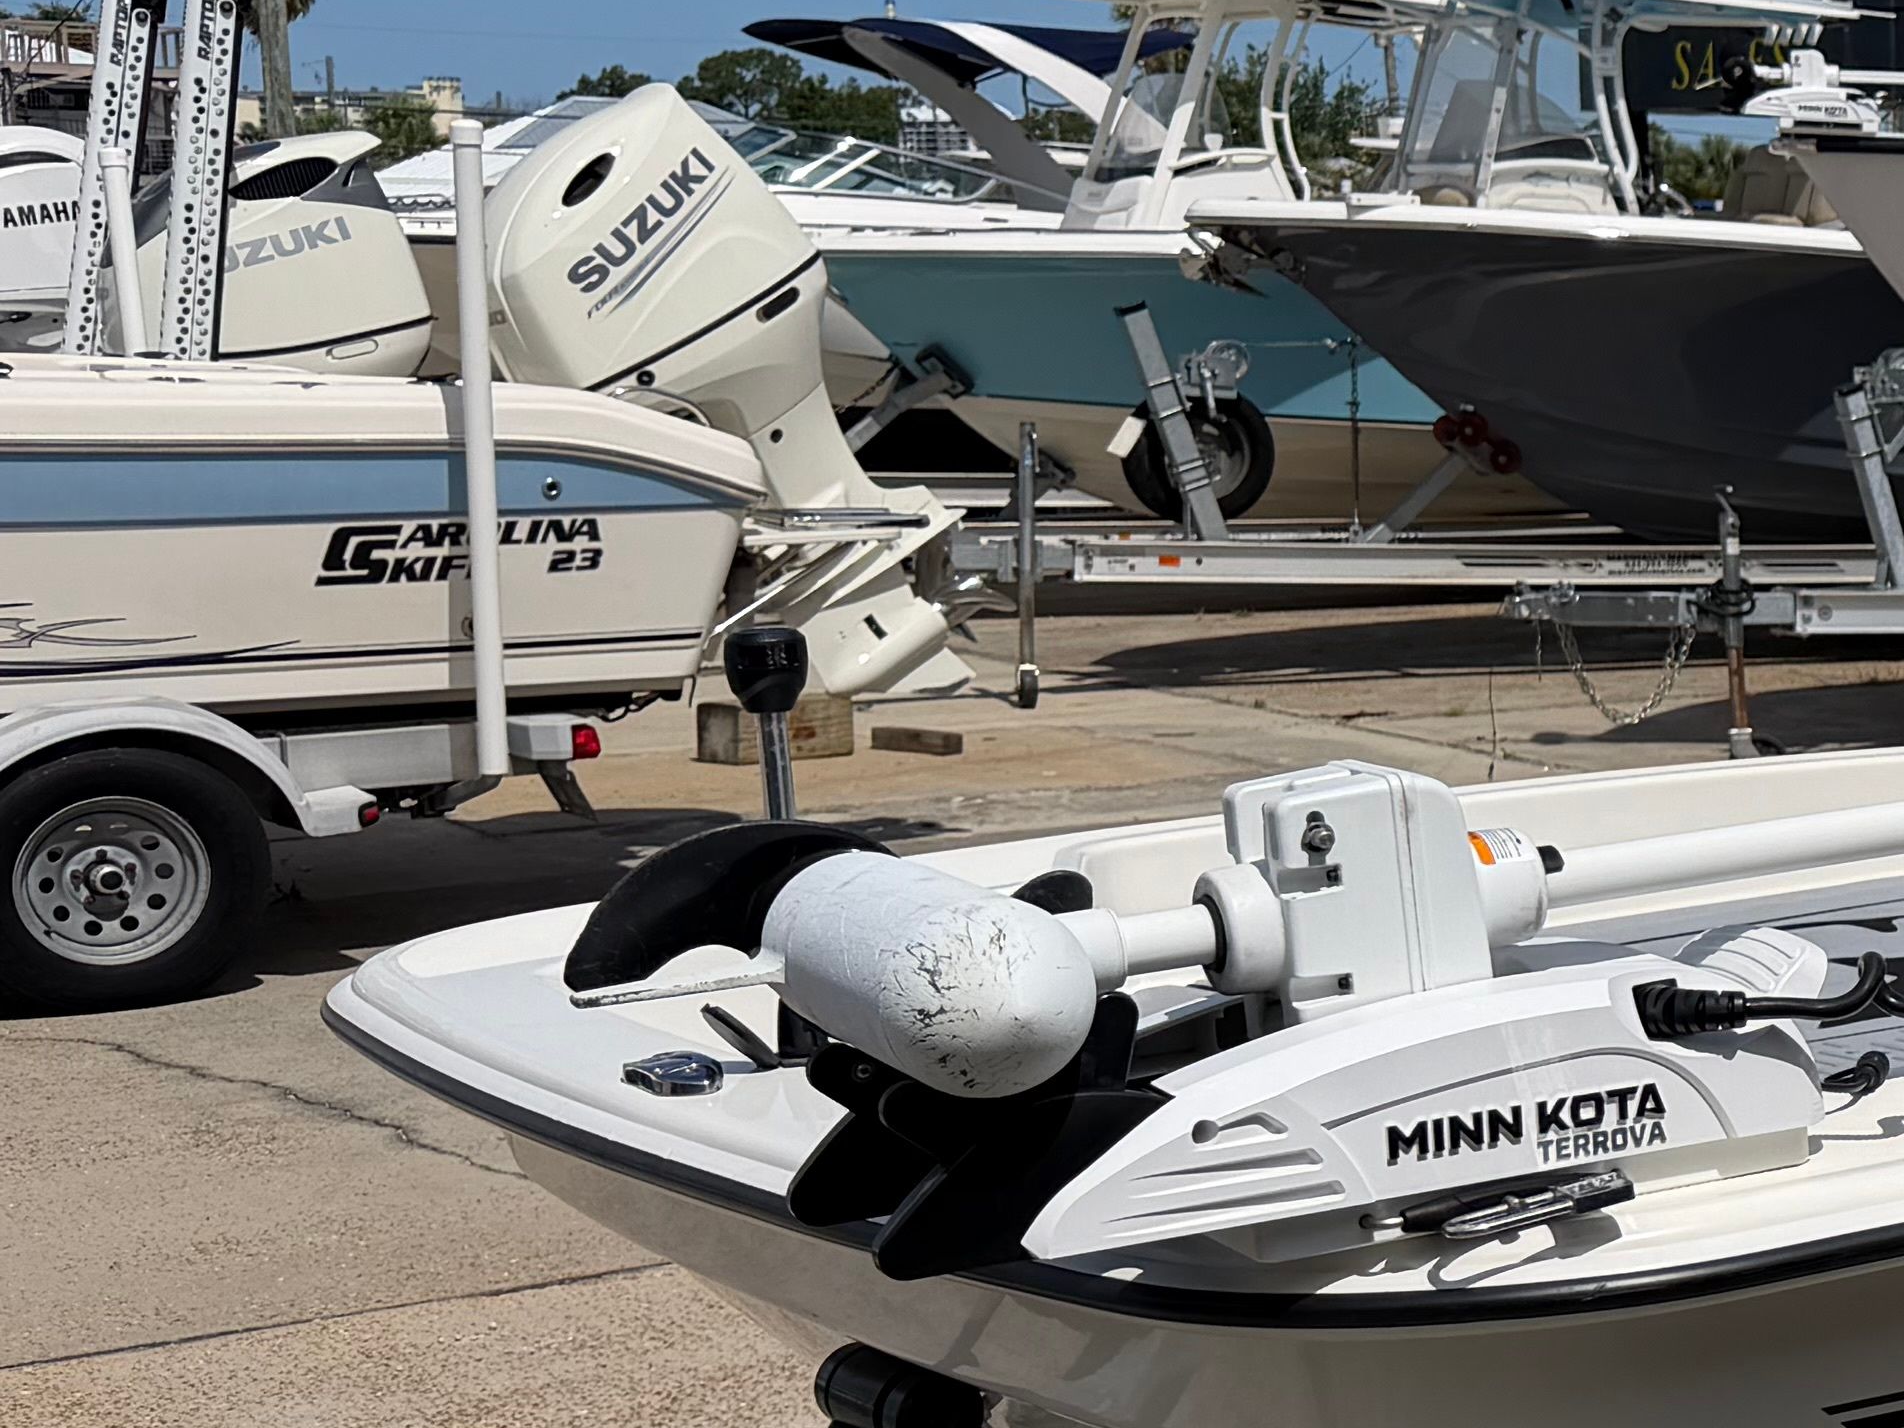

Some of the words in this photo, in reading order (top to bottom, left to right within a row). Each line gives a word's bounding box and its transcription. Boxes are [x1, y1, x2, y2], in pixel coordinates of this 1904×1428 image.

[3, 199, 81, 229] AMAHA
[567, 146, 715, 294] SUZUKI
[224, 215, 352, 274] UZUKI
[315, 538, 471, 586] SKIF
[547, 548, 603, 573] 23
[320, 517, 603, 572] CARLINA
[1386, 1104, 1524, 1166] MINN
[1535, 1082, 1667, 1135] KOTA
[1537, 1121, 1667, 1165] TERROVA
